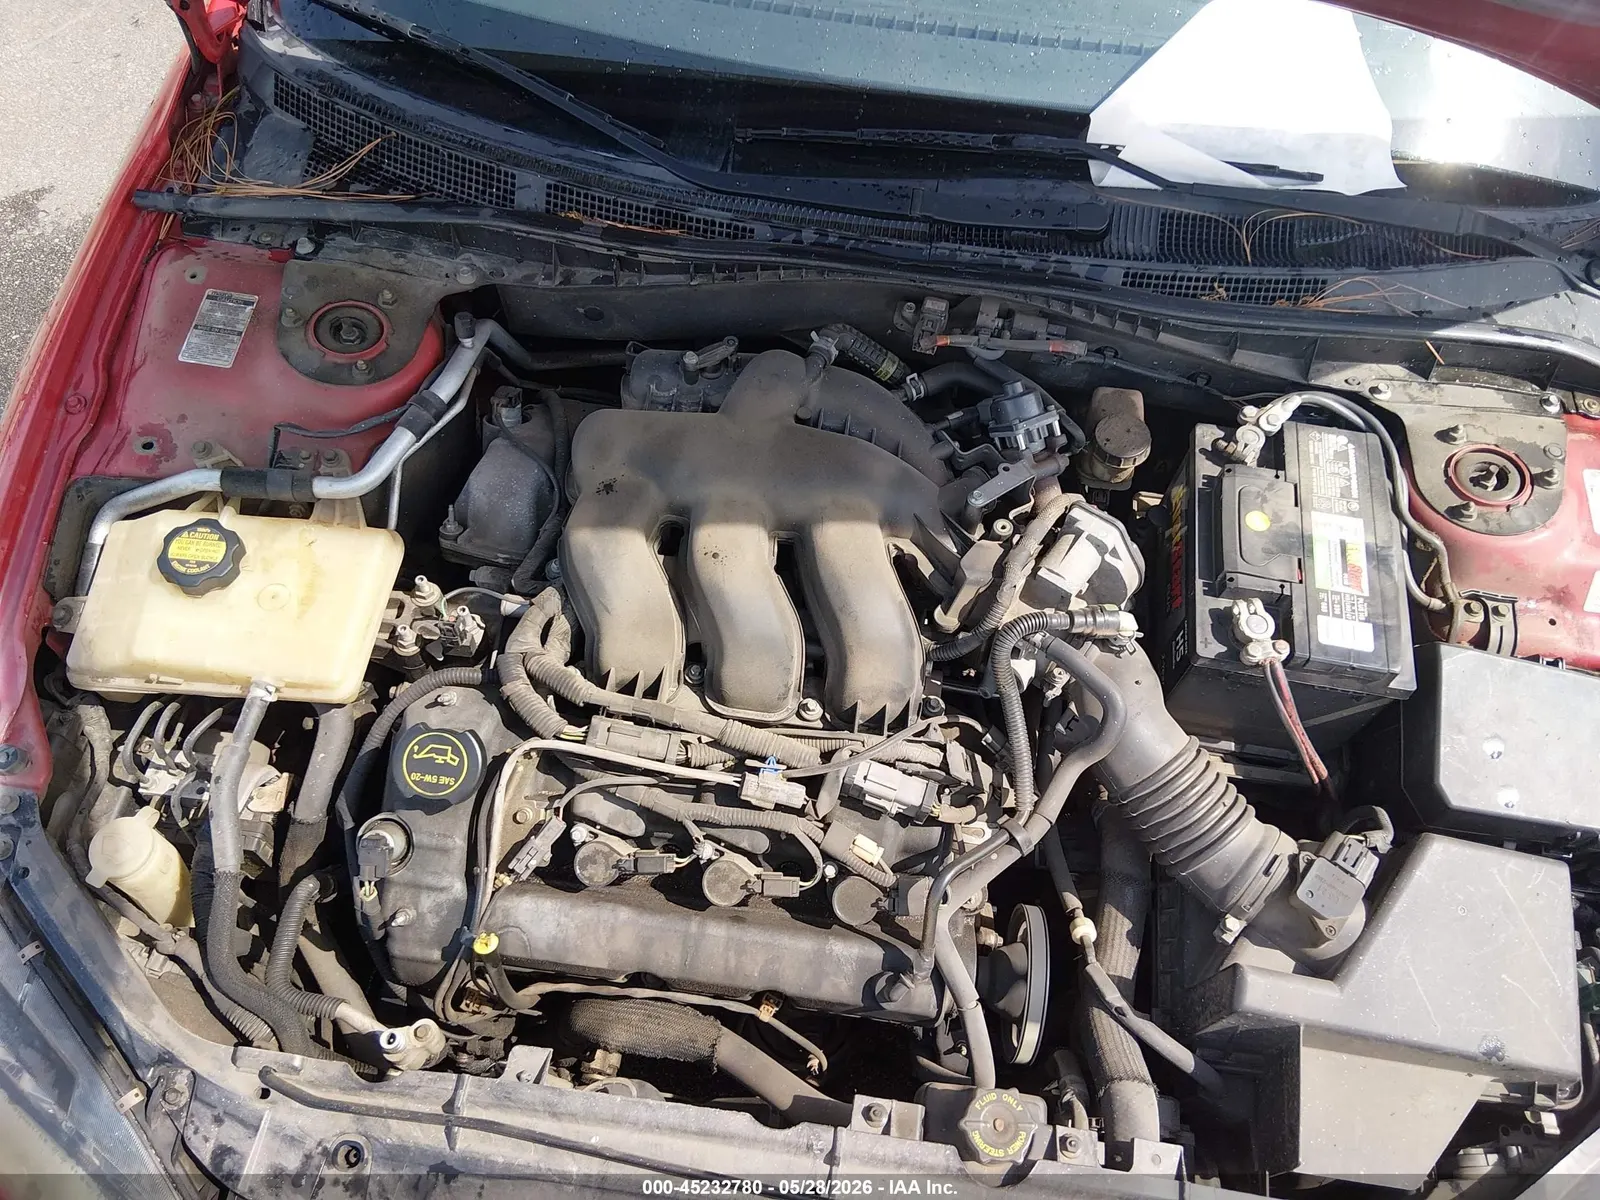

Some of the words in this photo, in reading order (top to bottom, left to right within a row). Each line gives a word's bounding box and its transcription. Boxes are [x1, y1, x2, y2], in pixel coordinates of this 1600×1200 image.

[189, 532, 219, 540] CAUTION
[1175, 629, 1184, 662] H5
[410, 772, 438, 783] 5W-20
[438, 776, 456, 785] SAE
[974, 1092, 997, 1110] FLUID
[1002, 1094, 1024, 1112] ONLY
[972, 1130, 1005, 1158] STEERING
[1006, 1131, 1027, 1155] POWER
